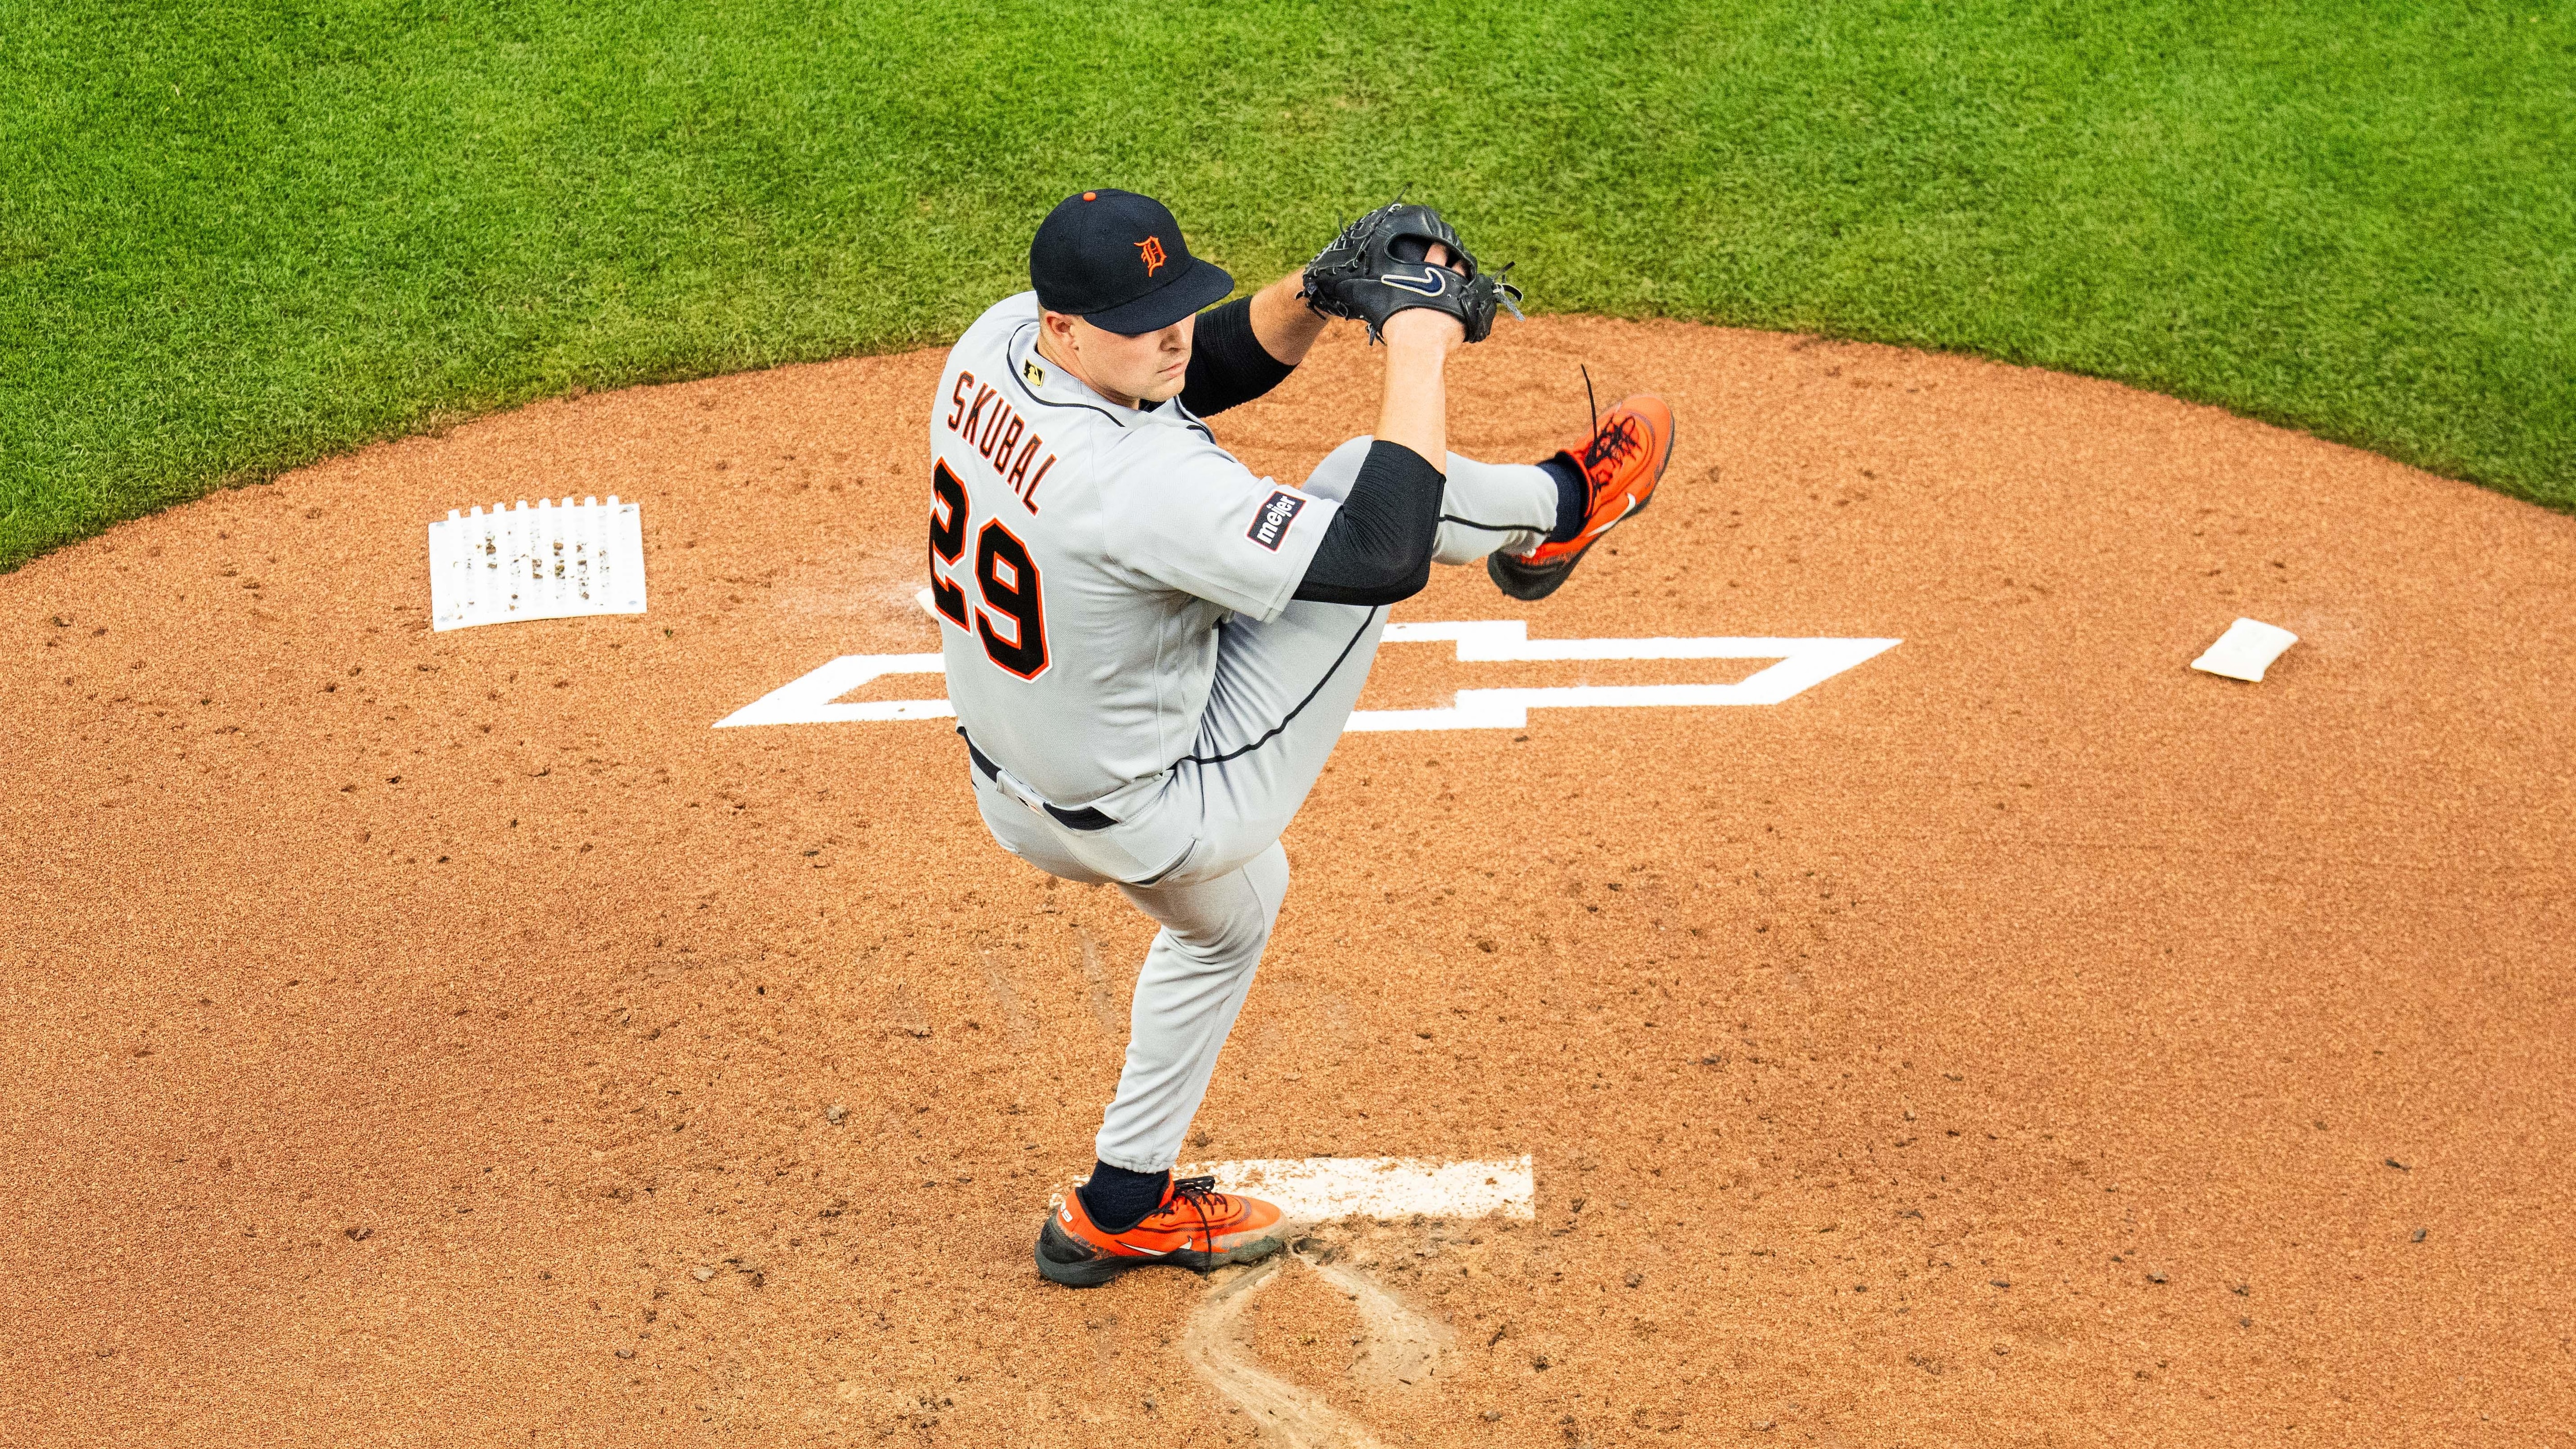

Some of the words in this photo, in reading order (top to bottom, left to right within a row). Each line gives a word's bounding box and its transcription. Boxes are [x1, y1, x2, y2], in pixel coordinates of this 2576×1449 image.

[947, 369, 1058, 517] SKUBAL
[928, 455, 1052, 682] 29
[1257, 495, 1296, 544] meijer
